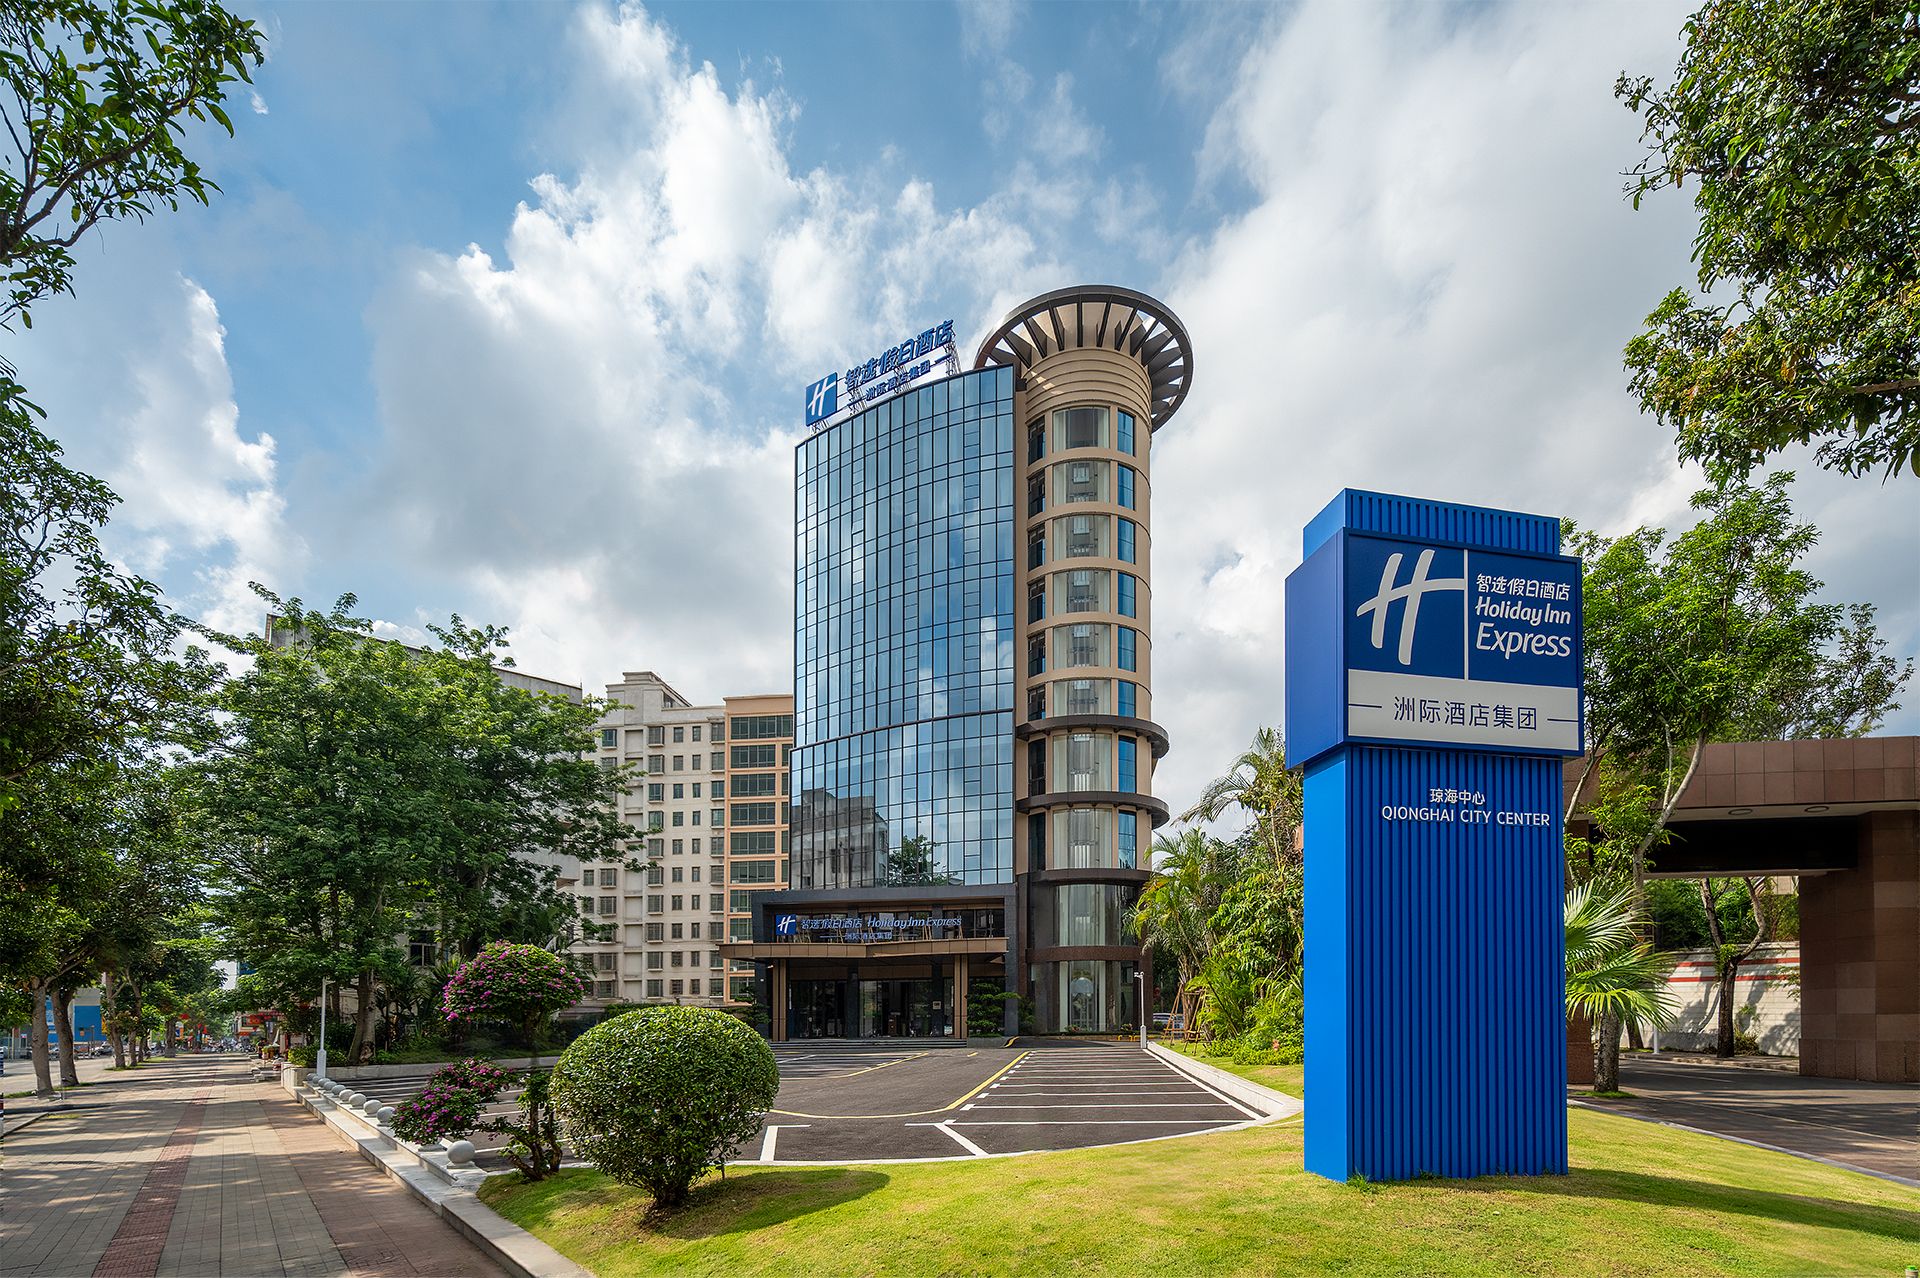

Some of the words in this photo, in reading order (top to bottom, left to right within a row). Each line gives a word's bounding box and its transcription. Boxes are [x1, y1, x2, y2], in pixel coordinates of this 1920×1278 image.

[844, 319, 954, 391] 智选假日酒店
[1476, 573, 1570, 601] 智选假日酒店
[1475, 596, 1540, 626] Holiday
[1544, 603, 1571, 625] Inn
[1476, 622, 1571, 659] Express
[1394, 696, 1537, 731] 洲际酒店集团
[1429, 788, 1486, 805] 琼海中心
[1382, 805, 1454, 823] QIONGHAI
[1460, 809, 1492, 824] CITY
[1497, 811, 1550, 827] CENTER
[867, 915, 907, 929] Holiday
[908, 916, 925, 927] Inn
[926, 917, 962, 927] Express
